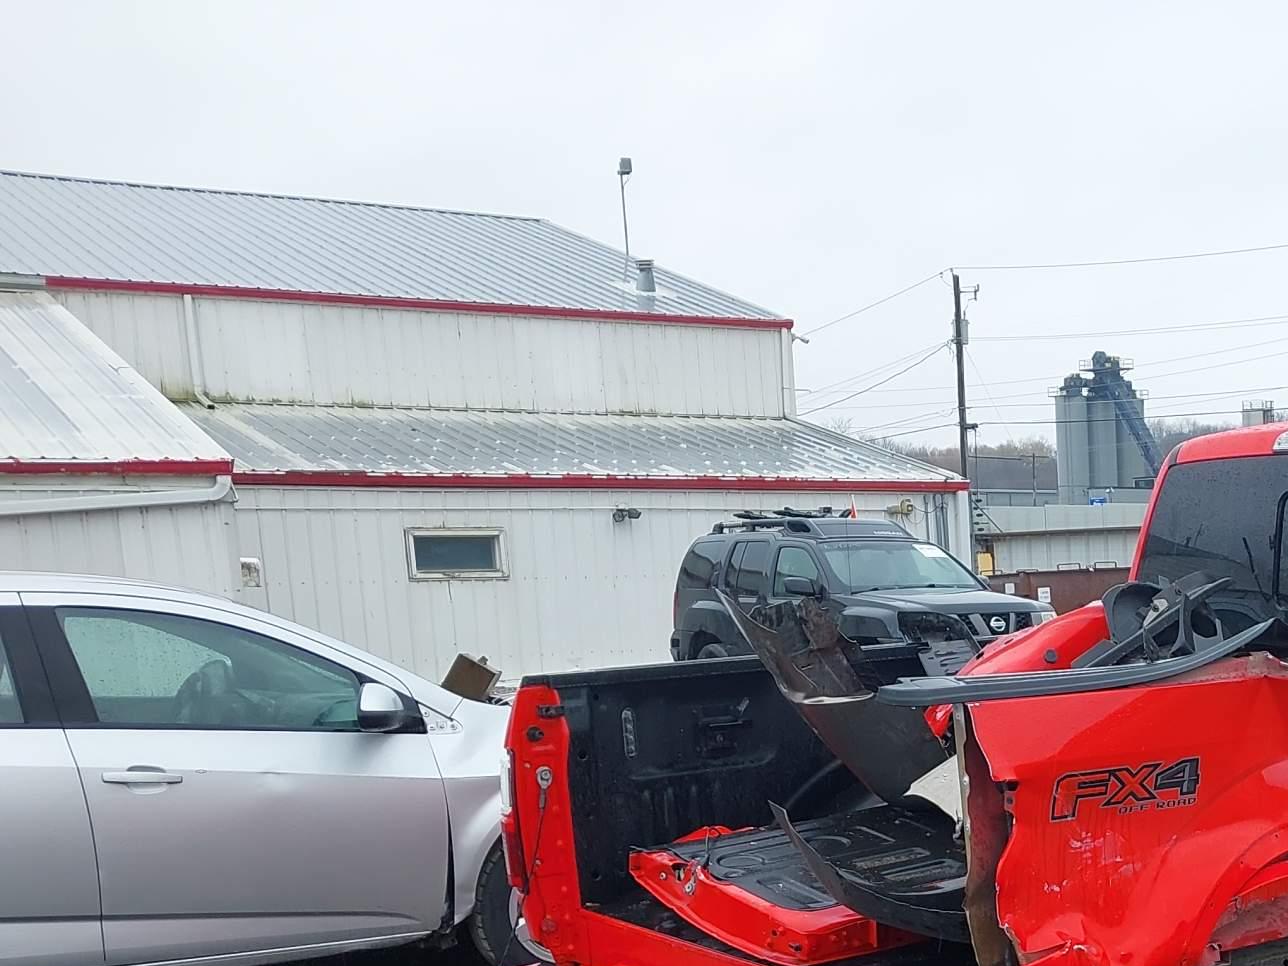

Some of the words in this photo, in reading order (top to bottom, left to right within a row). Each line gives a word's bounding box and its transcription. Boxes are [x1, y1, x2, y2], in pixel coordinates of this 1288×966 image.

[1050, 756, 1200, 823] FX4
[1118, 803, 1150, 815] OFF
[1155, 797, 1197, 809] ROAD
